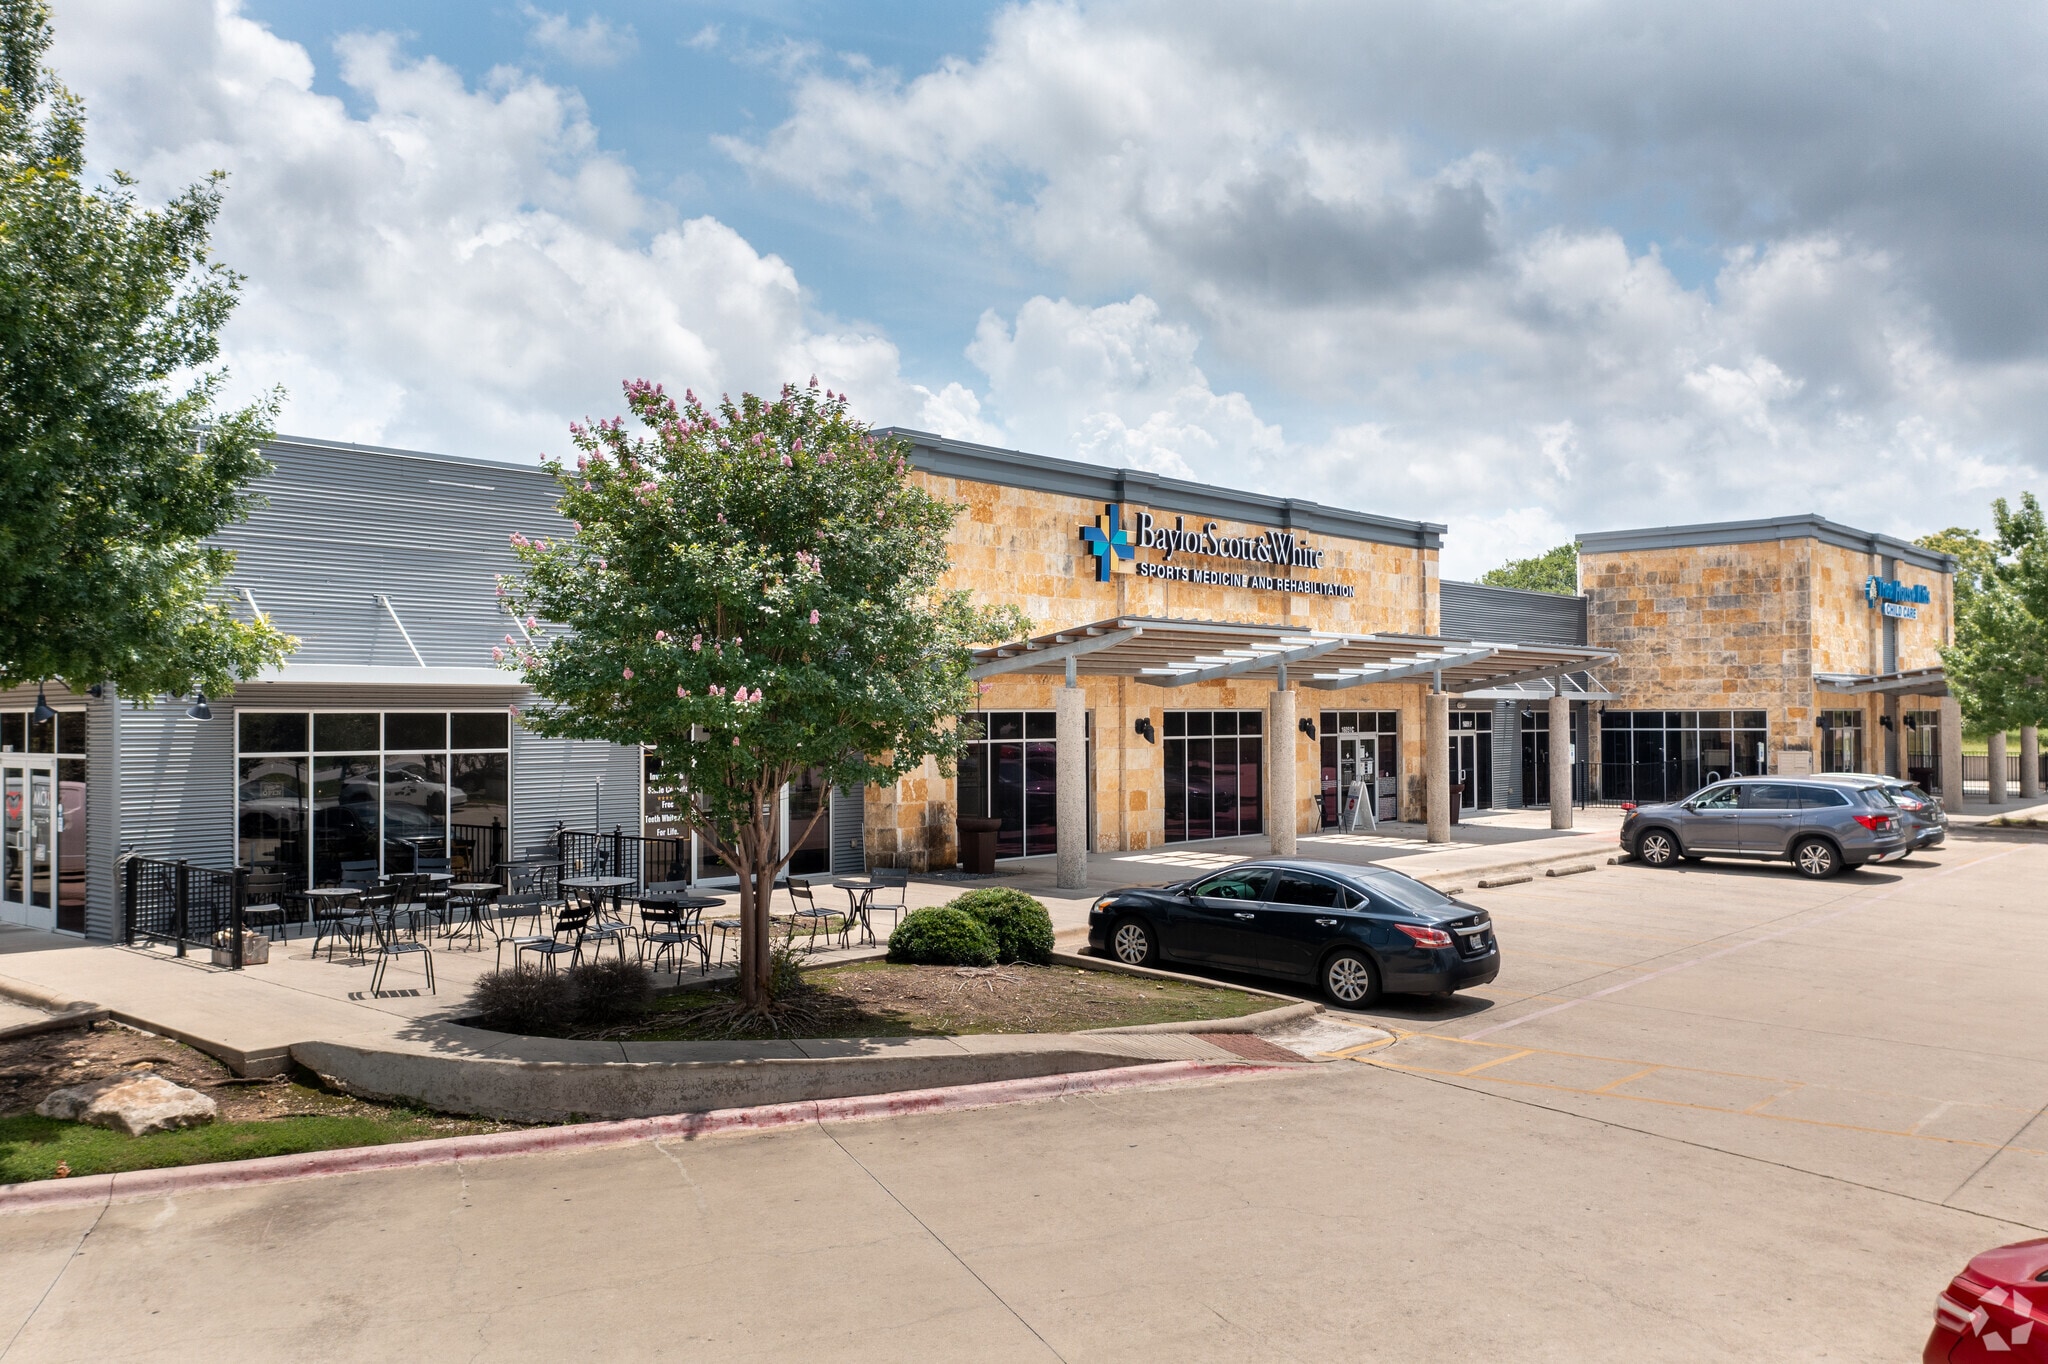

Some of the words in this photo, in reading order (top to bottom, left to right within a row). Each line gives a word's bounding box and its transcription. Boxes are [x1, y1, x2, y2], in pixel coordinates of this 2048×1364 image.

[1139, 562, 1190, 582] SPORTS
[1193, 569, 1248, 588] MEDICINE
[1251, 576, 1274, 591] AND
[1275, 578, 1356, 598] REHABILITATION
[1886, 603, 1902, 616] CHILD
[1902, 606, 1917, 619] CARE
[661, 800, 674, 808] Free
[645, 814, 661, 823] Teeth
[656, 828, 667, 837] For
